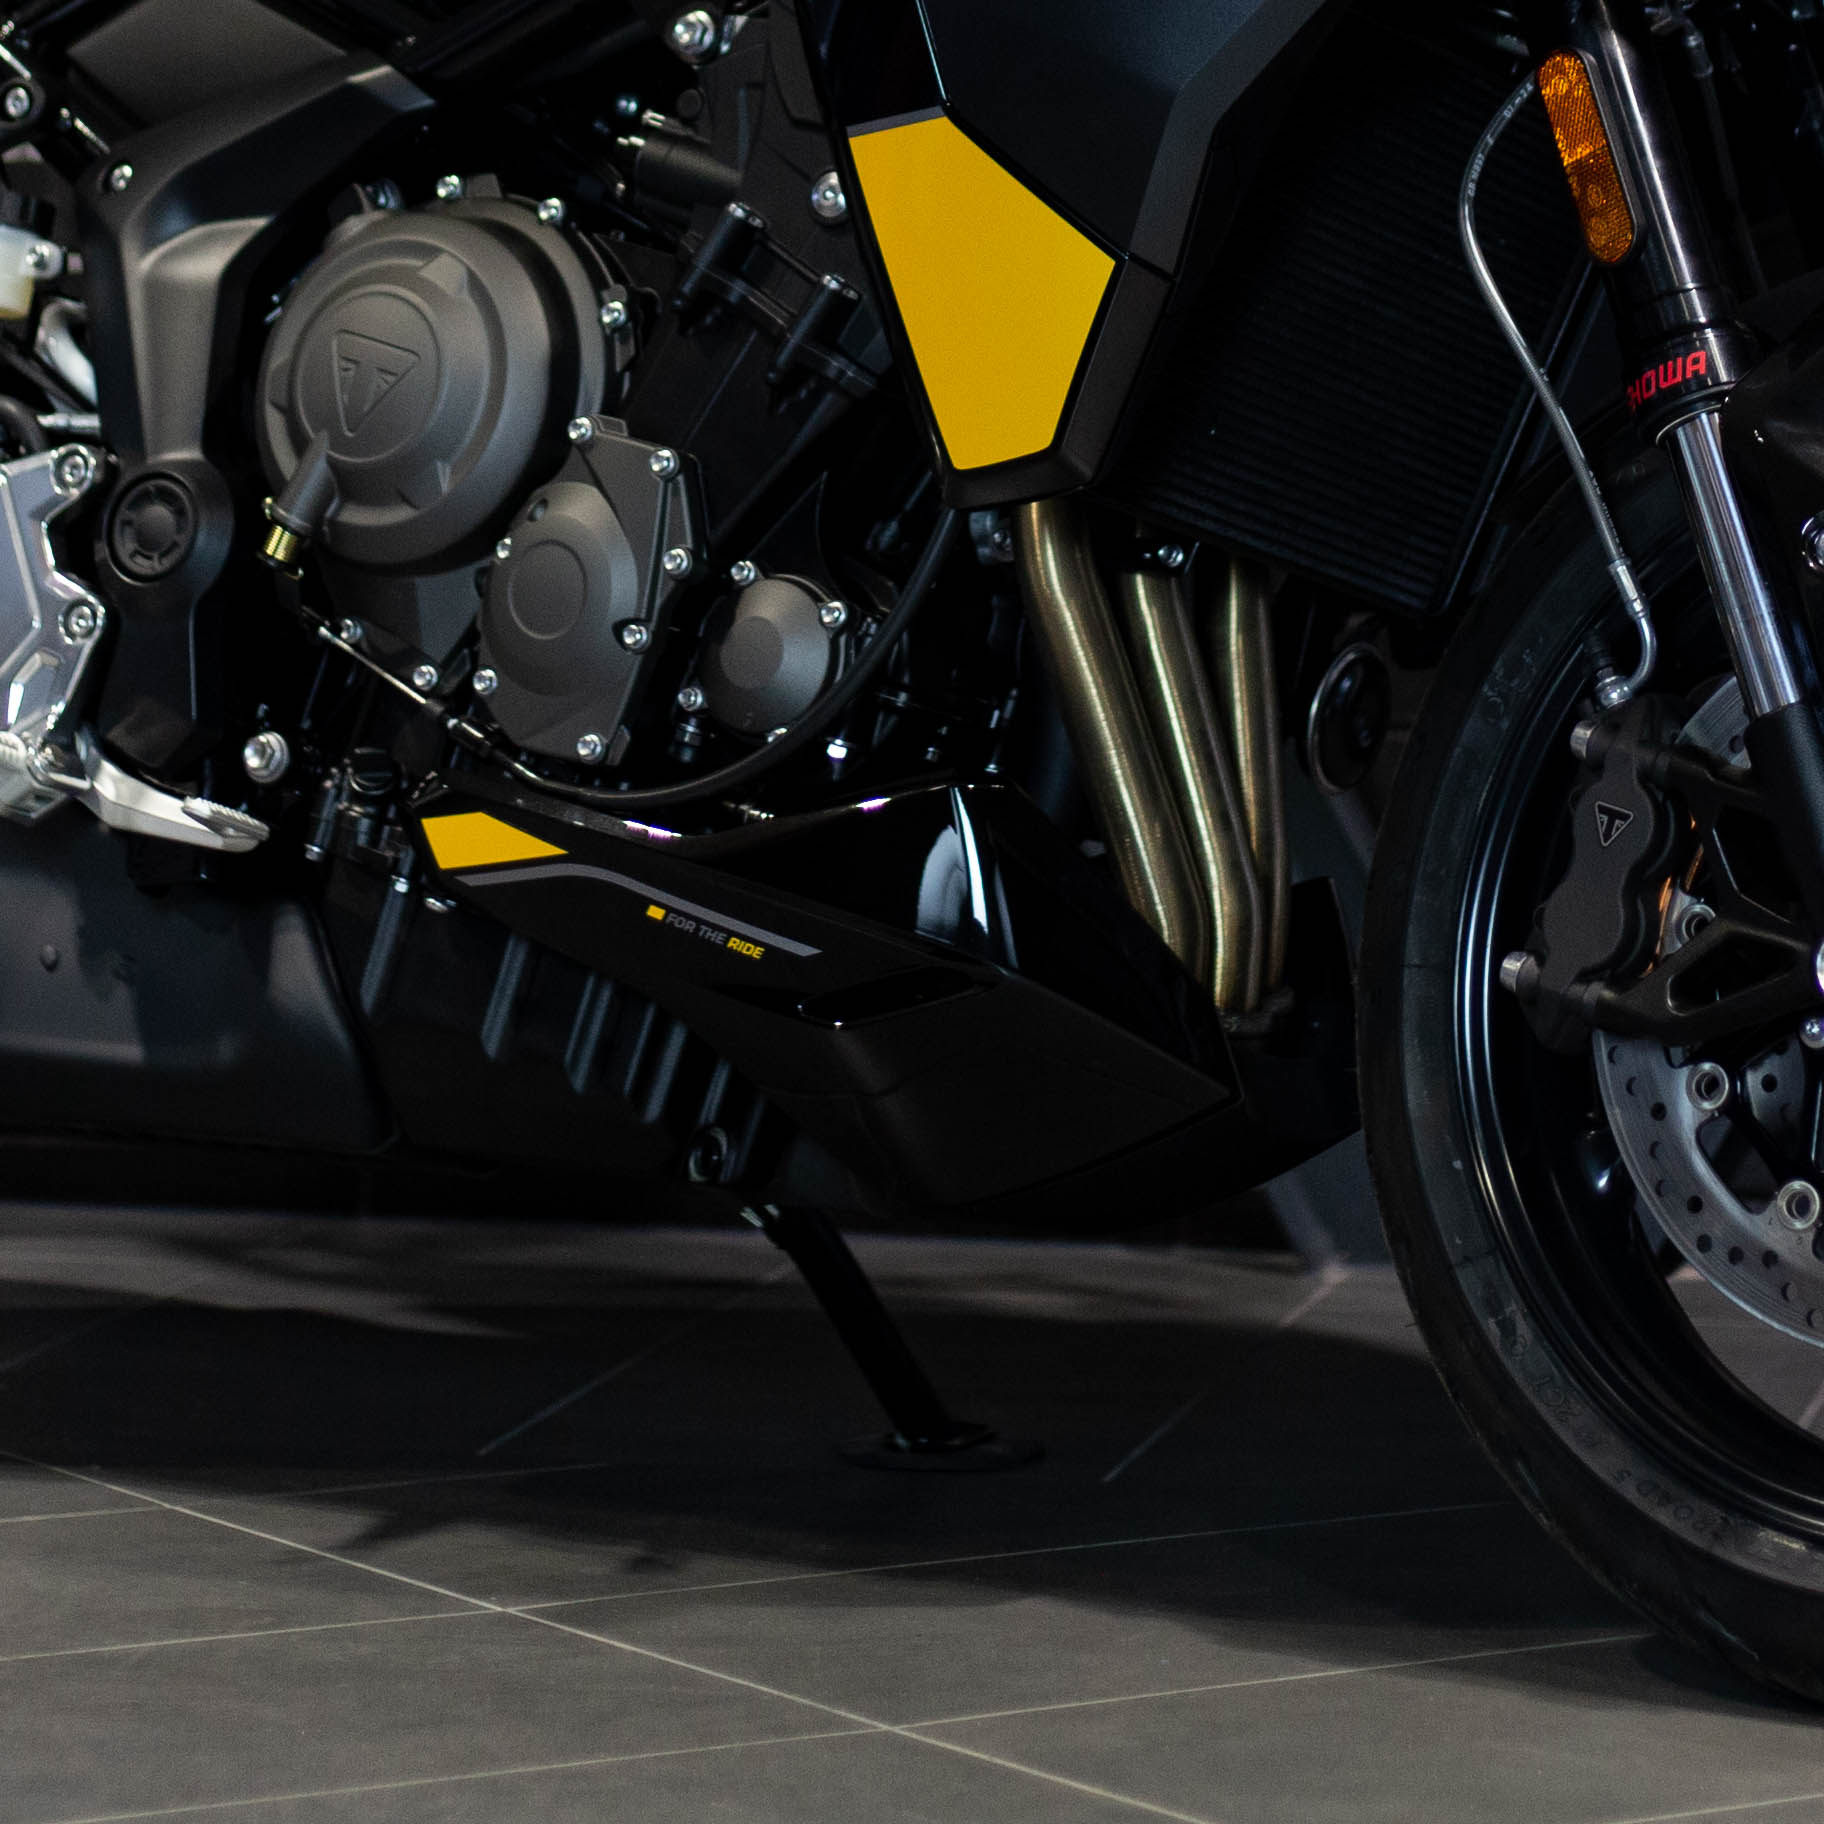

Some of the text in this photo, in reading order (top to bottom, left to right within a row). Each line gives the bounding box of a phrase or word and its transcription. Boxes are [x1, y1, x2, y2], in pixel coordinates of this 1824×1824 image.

[666, 913, 766, 960] FOR THE RIDE
